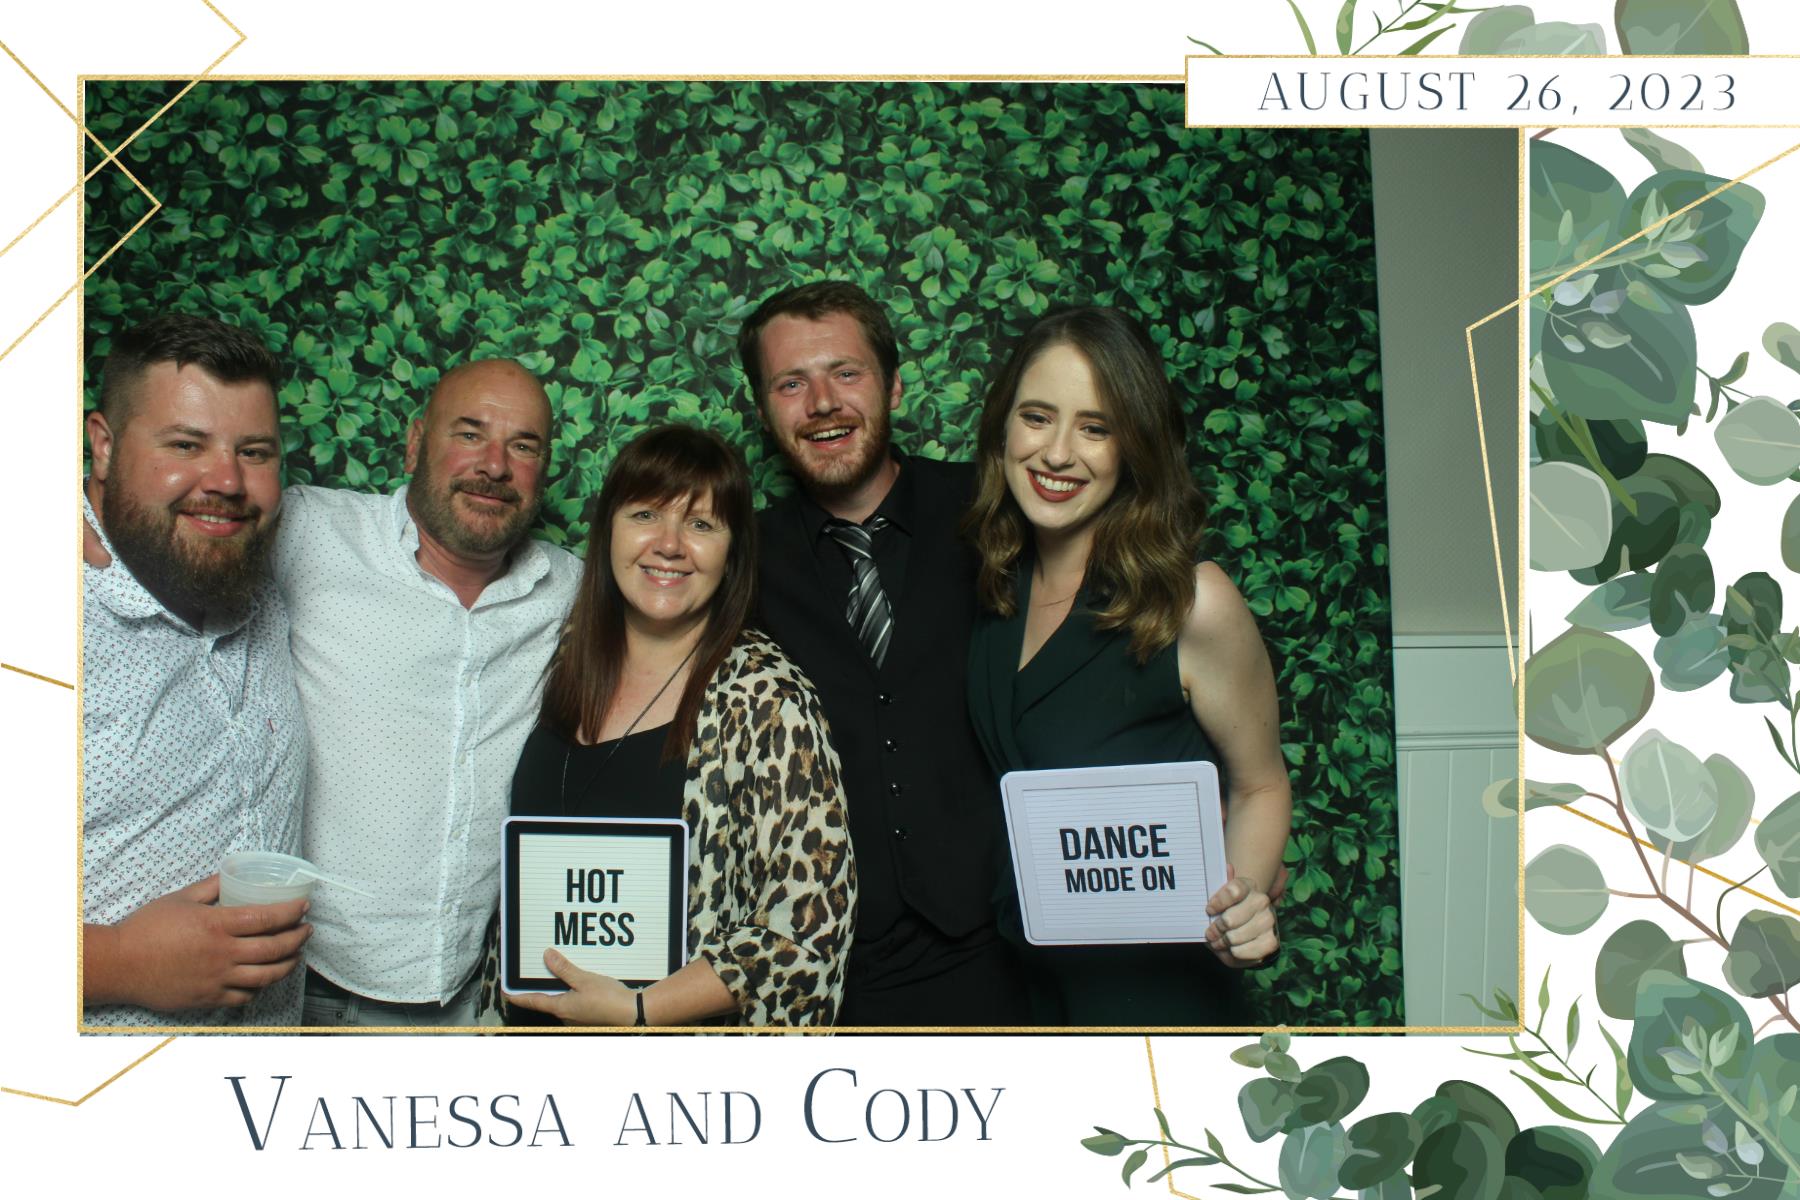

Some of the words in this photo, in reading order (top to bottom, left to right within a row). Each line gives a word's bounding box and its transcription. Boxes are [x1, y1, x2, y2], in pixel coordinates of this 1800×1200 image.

[1060, 824, 1169, 860] DANCE
[567, 869, 624, 903] HOT
[1065, 867, 1135, 892] MODE
[1142, 866, 1175, 890] ON
[555, 912, 634, 946] MESS
